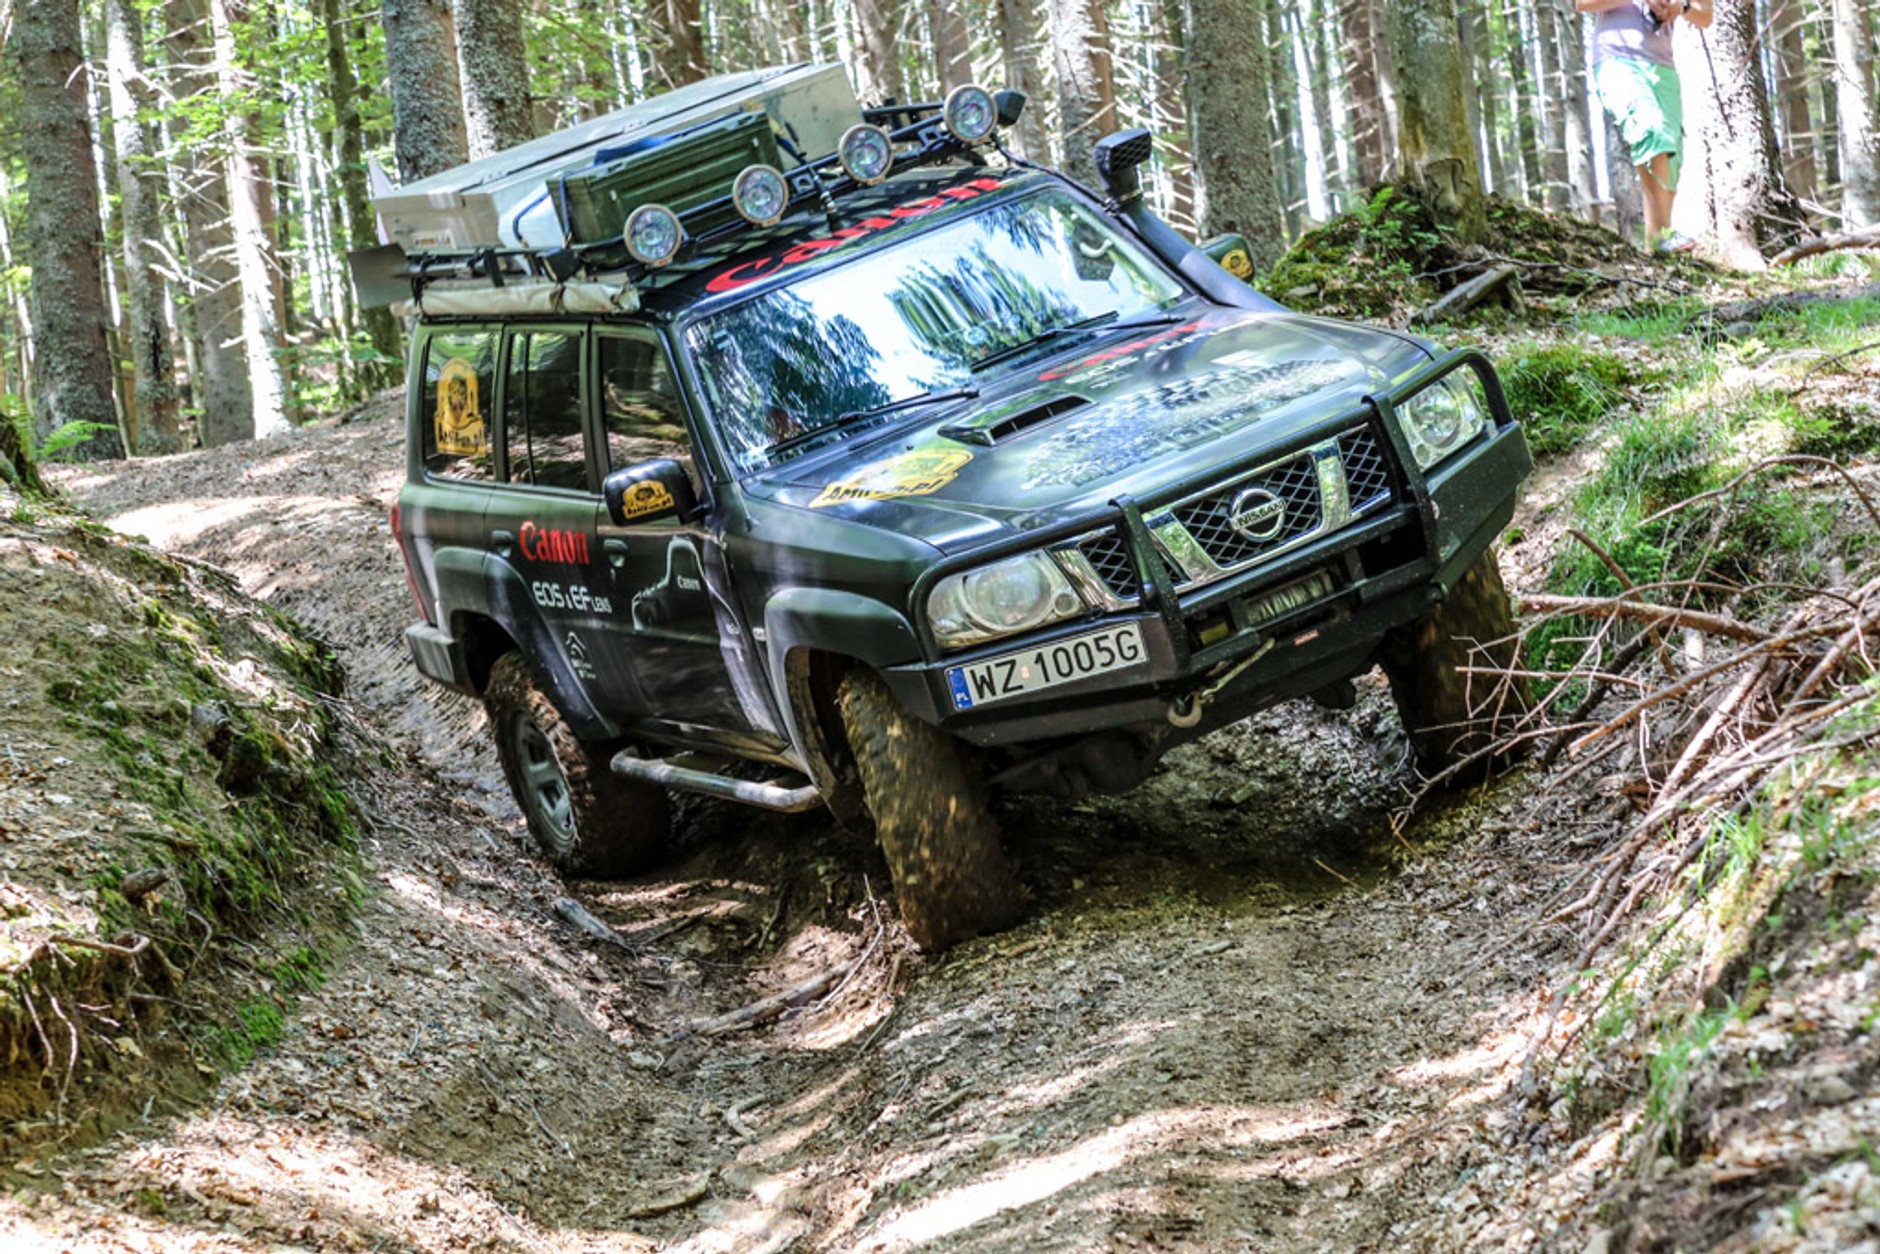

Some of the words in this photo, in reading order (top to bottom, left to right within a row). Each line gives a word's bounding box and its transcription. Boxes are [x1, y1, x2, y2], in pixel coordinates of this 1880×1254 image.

[705, 177, 1006, 292] Canon
[1237, 499, 1285, 527] NISSAN
[519, 520, 590, 565] Canon
[532, 581, 565, 608] EOS
[569, 585, 592, 611] EF
[969, 659, 1024, 699] WZ
[1034, 630, 1139, 683] 1005G
